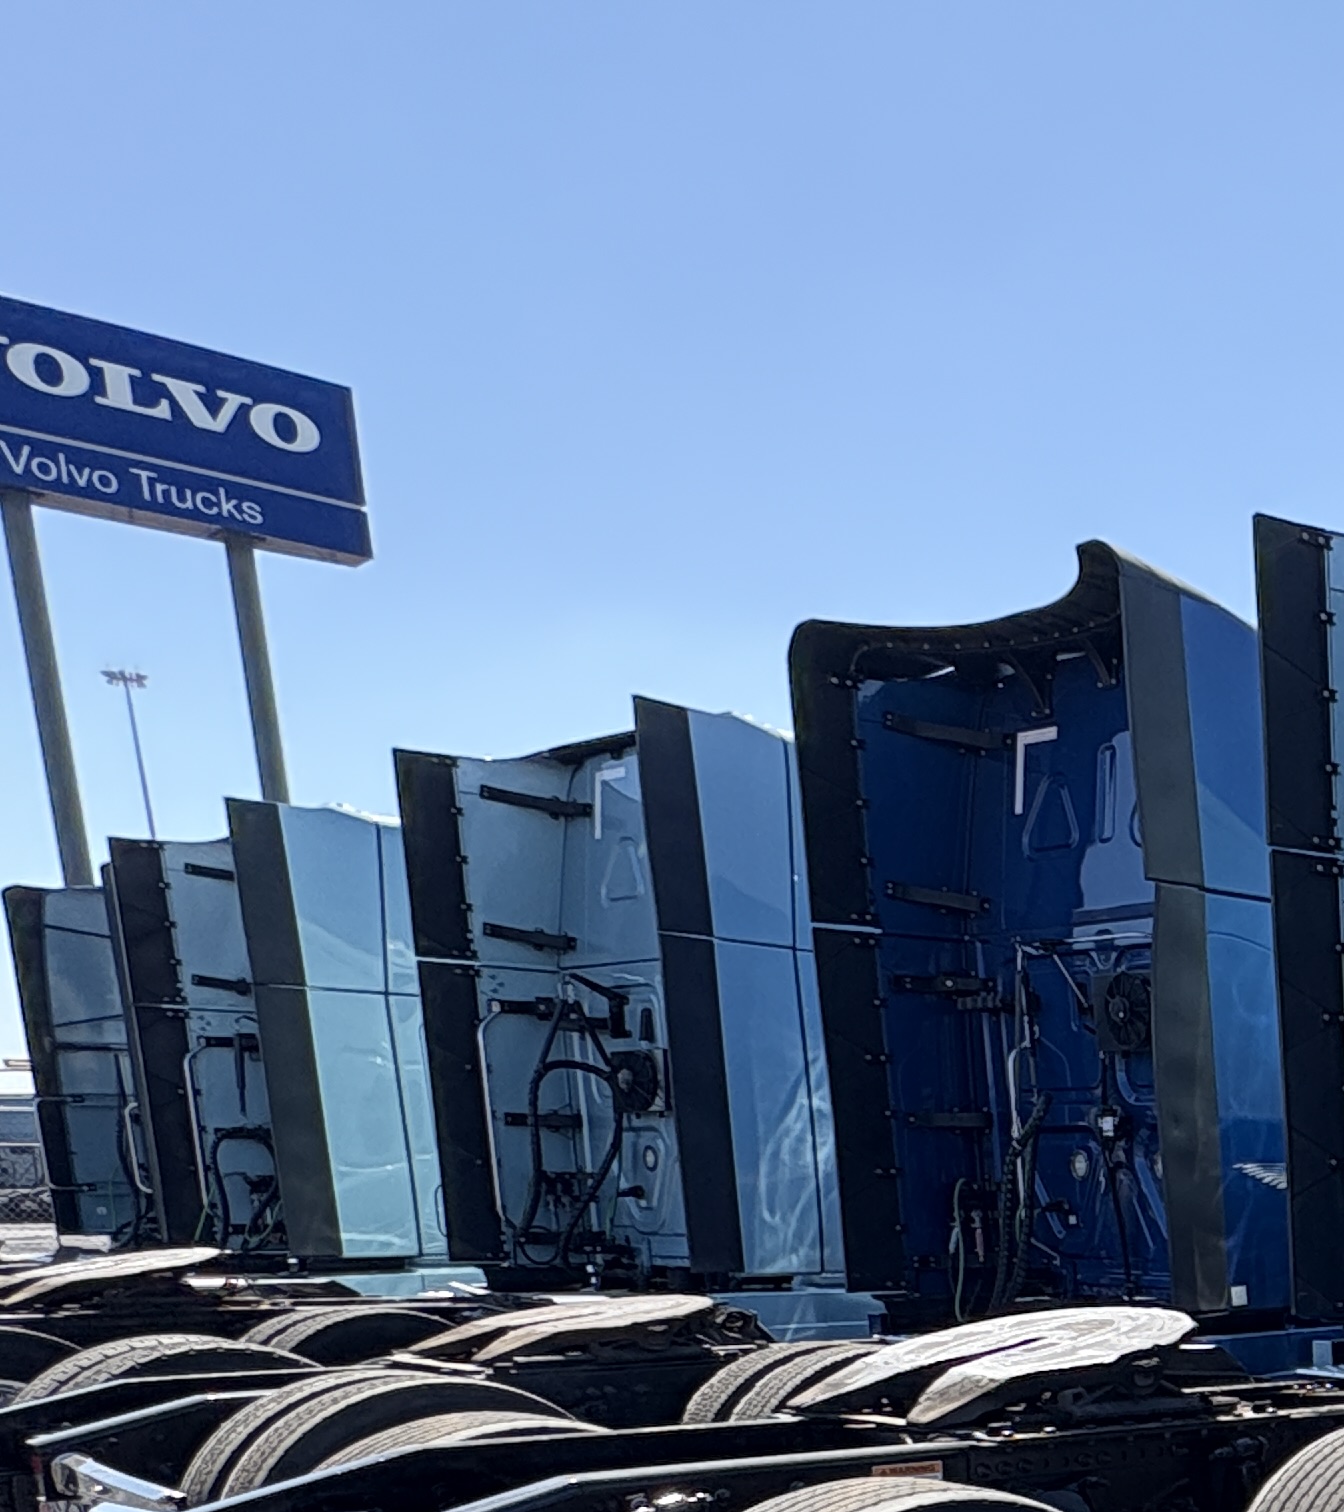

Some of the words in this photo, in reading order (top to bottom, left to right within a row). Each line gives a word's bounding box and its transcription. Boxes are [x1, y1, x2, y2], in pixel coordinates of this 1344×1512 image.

[0, 336, 320, 453] OLVO
[0, 440, 119, 494] Volvo
[129, 467, 264, 525] Trucks
